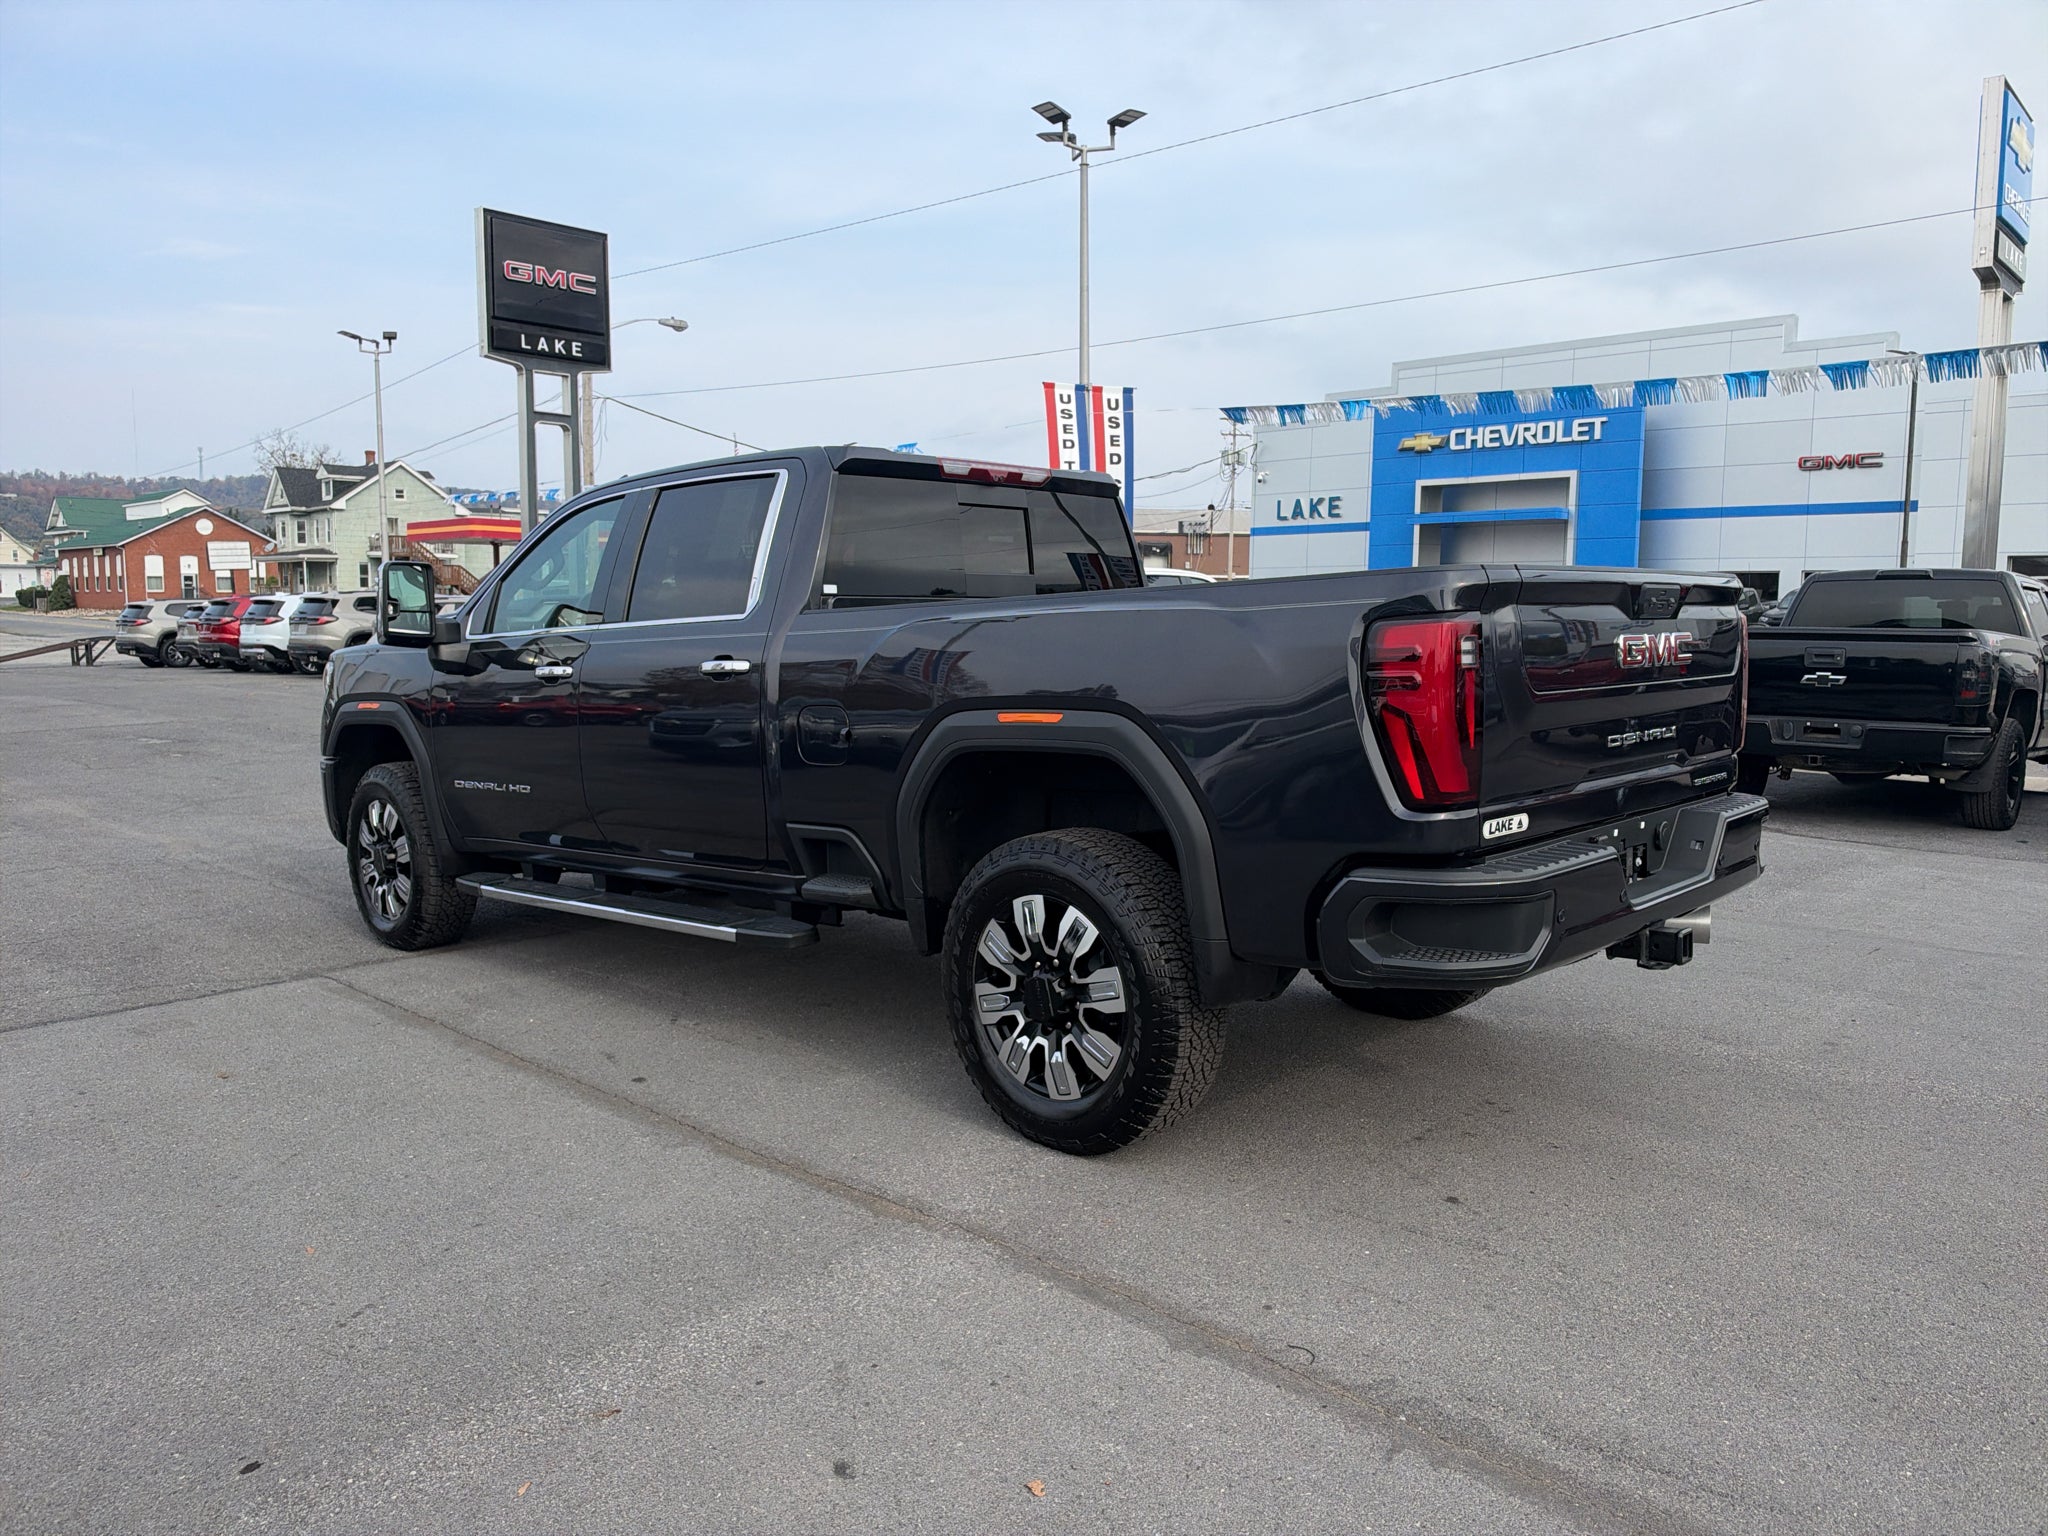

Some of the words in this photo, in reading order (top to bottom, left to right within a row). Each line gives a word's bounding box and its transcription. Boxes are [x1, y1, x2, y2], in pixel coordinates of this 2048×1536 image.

[2005, 241, 2023, 272] LAKE
[503, 259, 597, 295] GMC
[520, 333, 583, 358] LAKE
[1059, 393, 1075, 449] USED
[1107, 398, 1122, 466] USED
[1448, 416, 1608, 452] CHEVROLET
[1798, 452, 1883, 471] GMC
[1276, 495, 1343, 523] LAKE
[1616, 631, 1693, 669] GMC
[1607, 725, 1677, 748] DENALI
[454, 779, 506, 792] DENALI
[508, 783, 531, 793] HD
[1693, 772, 1728, 786] SIERRA
[1489, 818, 1514, 836] LAKE
